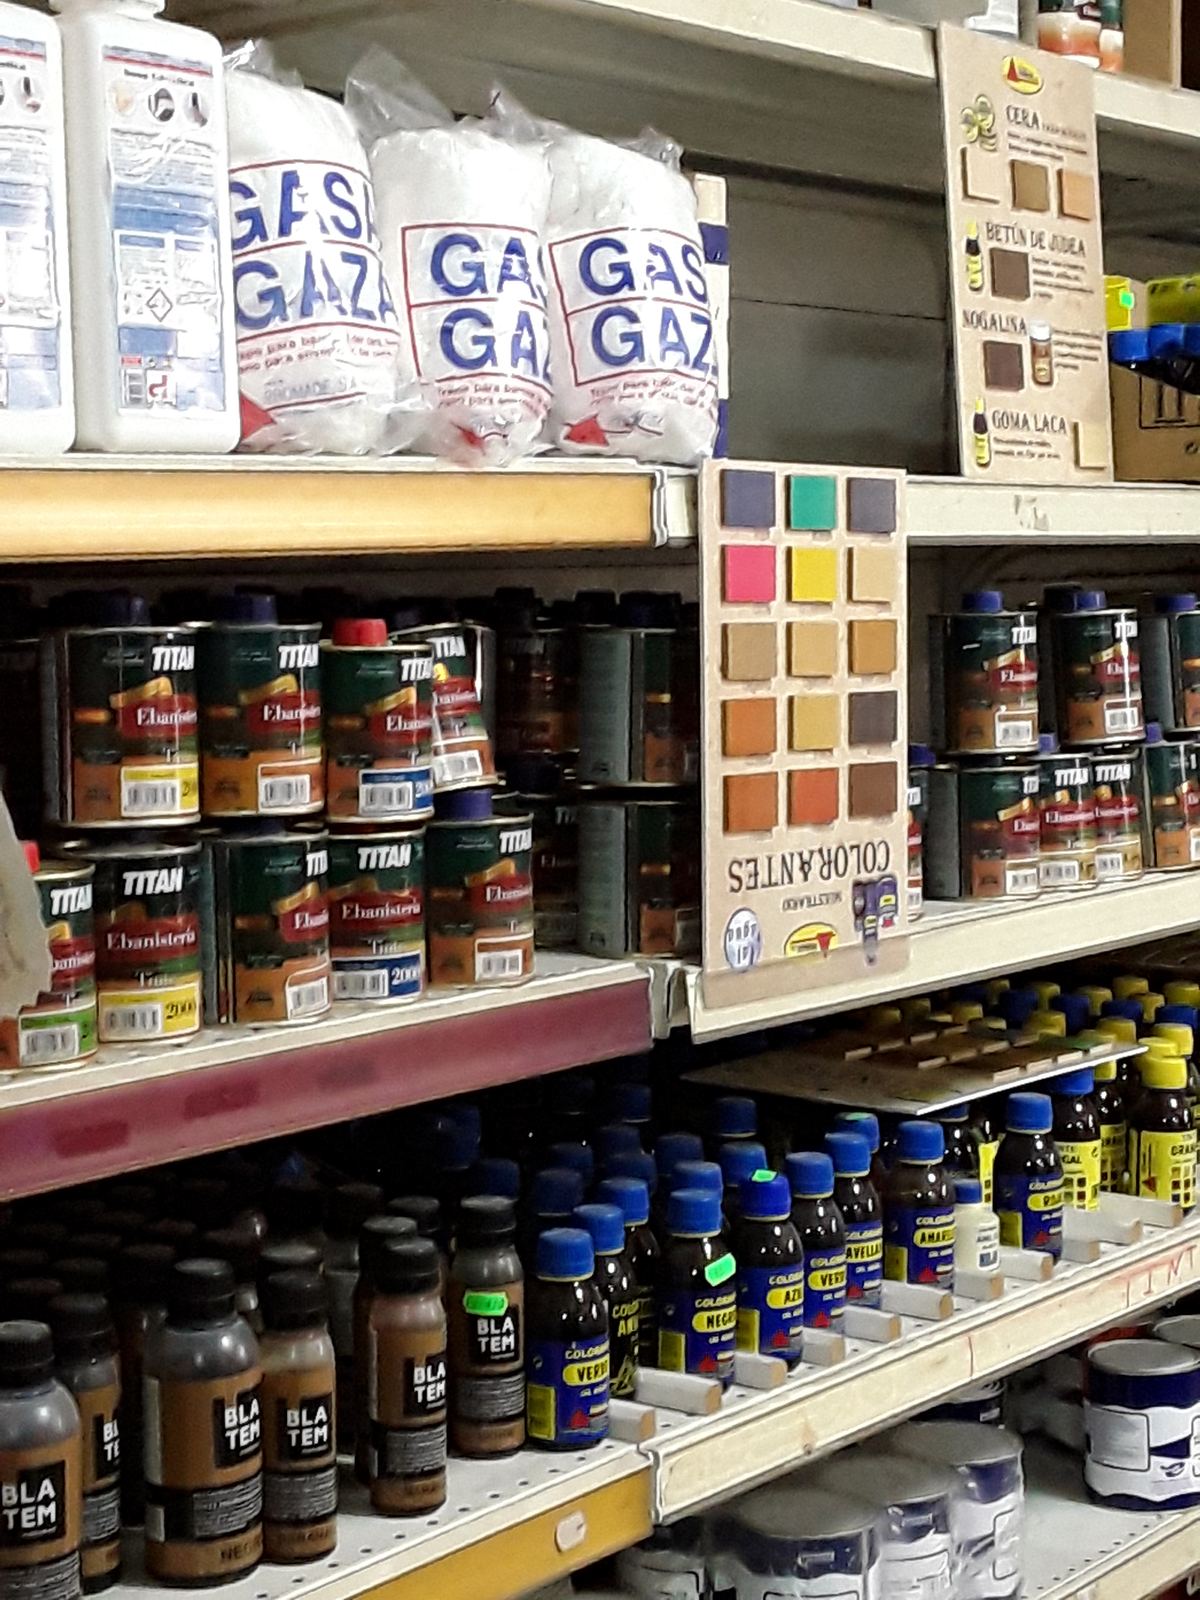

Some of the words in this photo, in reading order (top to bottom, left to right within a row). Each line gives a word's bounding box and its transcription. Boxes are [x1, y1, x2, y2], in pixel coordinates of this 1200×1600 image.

[1006, 104, 1040, 131] CERA
[230, 168, 379, 250] GAS
[430, 232, 549, 306] GA
[439, 308, 553, 385] GA
[1033, 413, 1067, 435] LACA
[358, 843, 411, 870] TITAN
[728, 840, 890, 893] COLORANTES
[123, 867, 183, 896] TITAN
[477, 1315, 515, 1336] BLA
[477, 1333, 515, 1354] TEM
[413, 1361, 446, 1385] BLA
[413, 1379, 446, 1405] TEM
[224, 1398, 260, 1428] BLA
[286, 1404, 328, 1428] BLA
[224, 1419, 261, 1450] TEM
[287, 1426, 328, 1448] TEM
[1, 1478, 57, 1505] BLA
[1, 1501, 57, 1531] TEM
